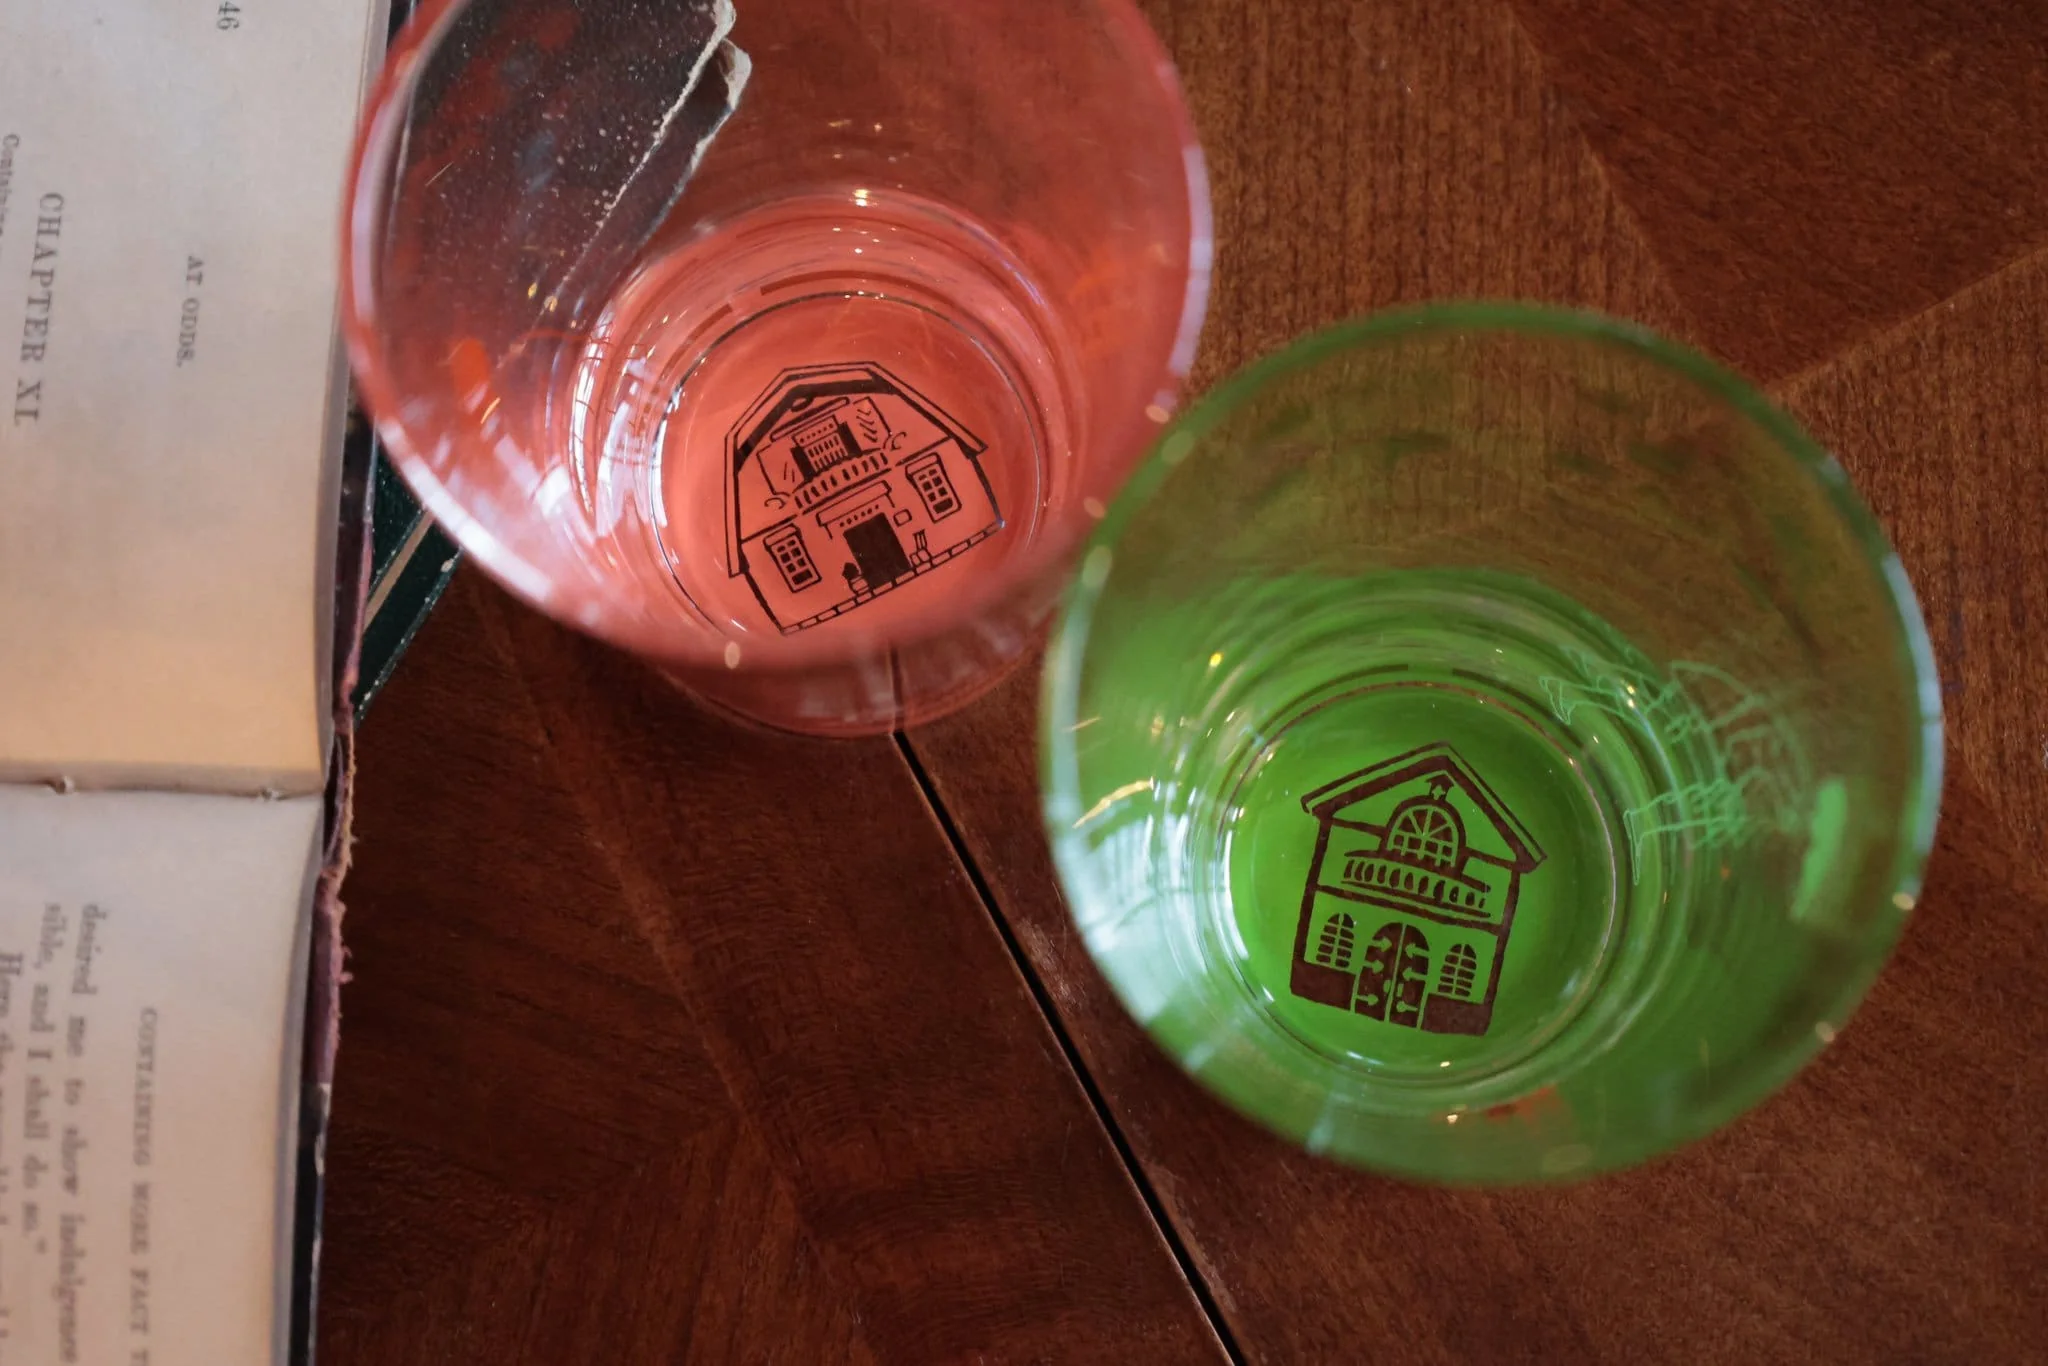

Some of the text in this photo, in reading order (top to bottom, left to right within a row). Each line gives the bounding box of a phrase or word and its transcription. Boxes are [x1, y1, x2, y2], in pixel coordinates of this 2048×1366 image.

[0, 133, 20, 237] Containi
[20, 192, 64, 363] CHAPTER
[186, 255, 204, 286] AT
[29, 983, 56, 1033] and
[27, 1048, 53, 1060] I
[132, 1007, 158, 1167] CONTAINING
[23, 1073, 50, 1139] shall
[51, 903, 107, 1364] desired me to show indulgence
[22, 1152, 49, 1190] do
[129, 1181, 150, 1256] MORE
[129, 1268, 150, 1335] FACT
